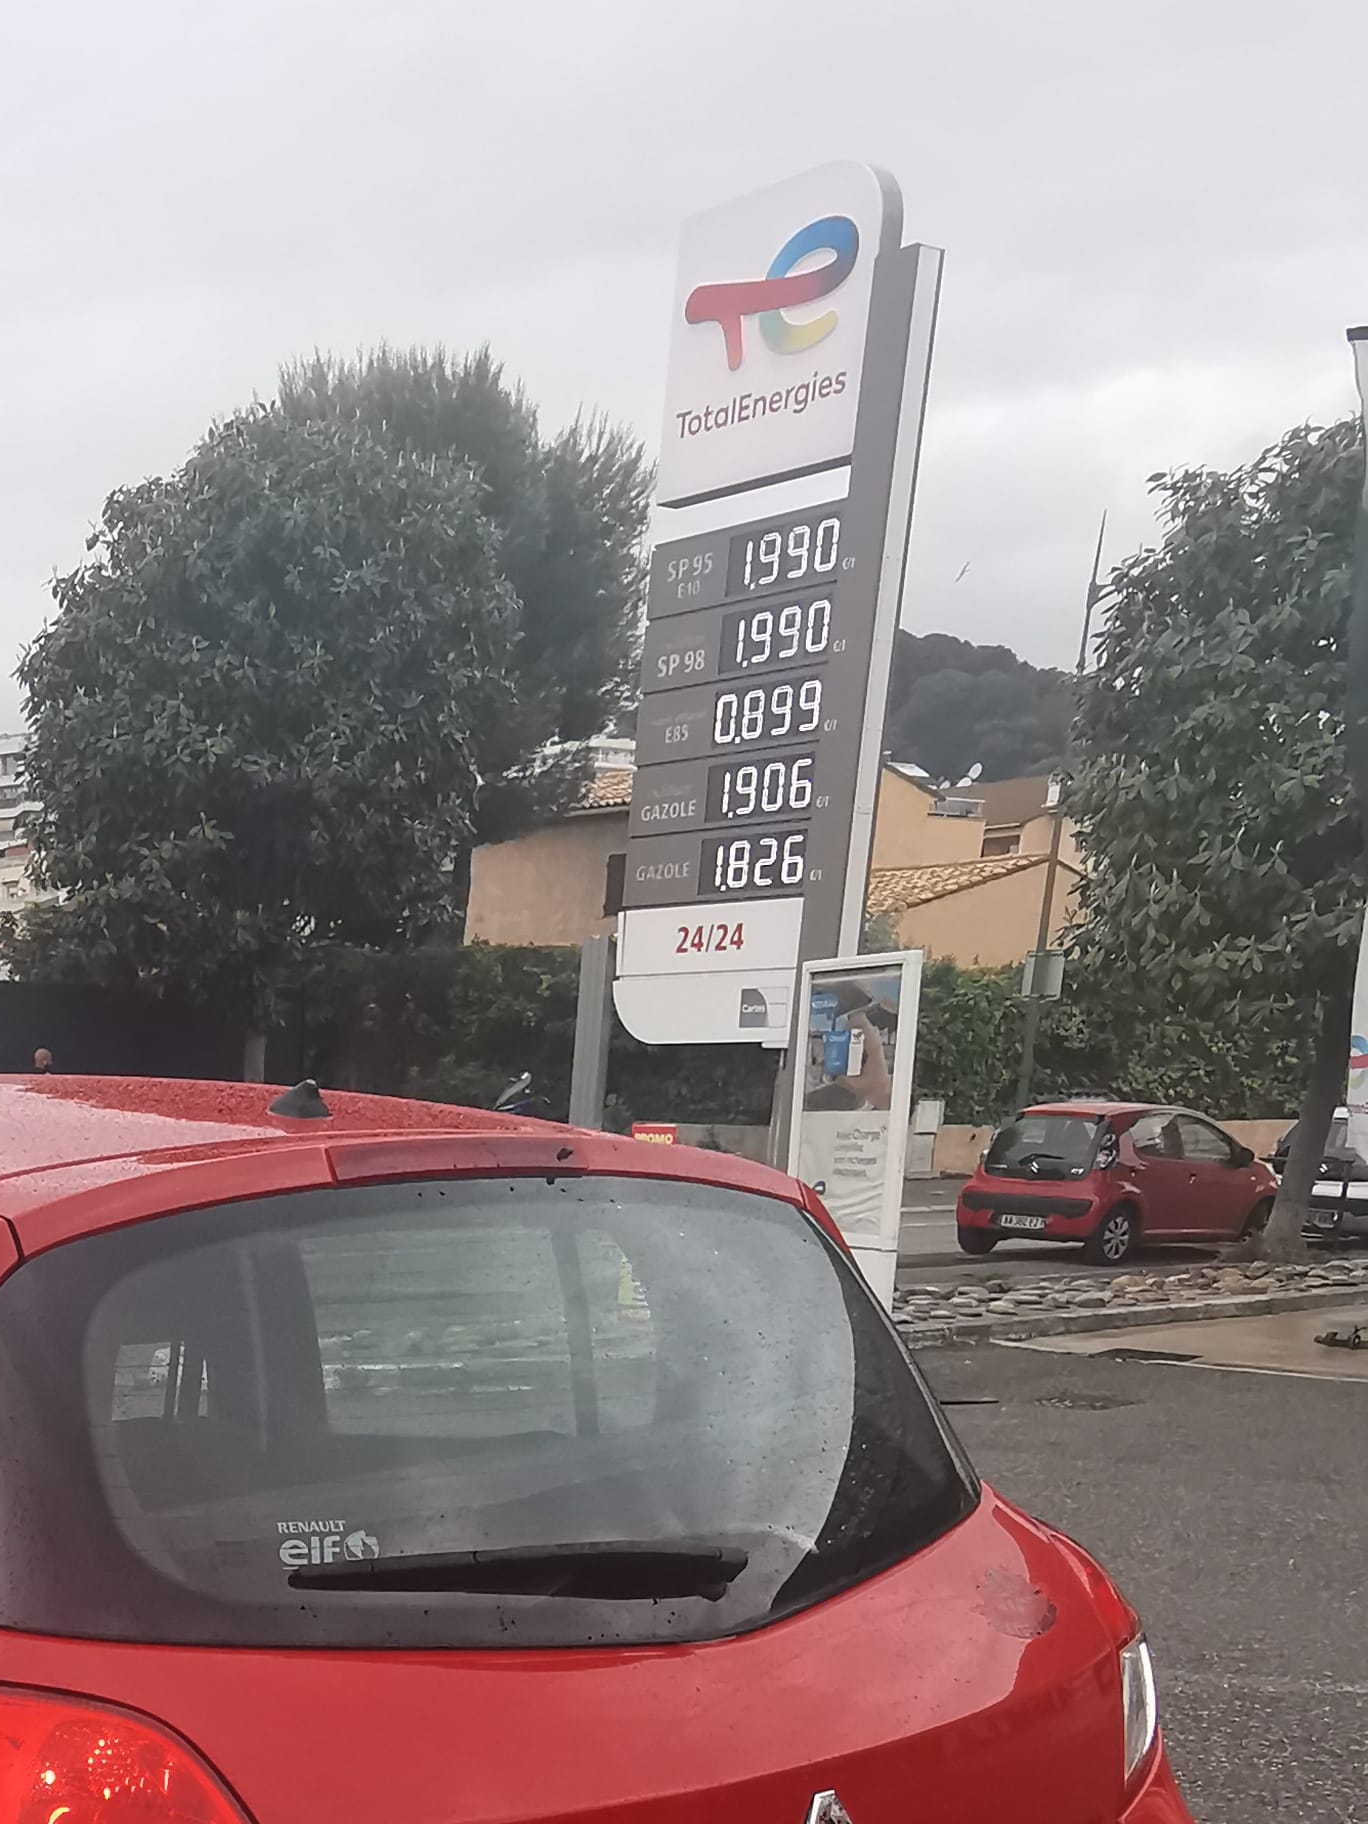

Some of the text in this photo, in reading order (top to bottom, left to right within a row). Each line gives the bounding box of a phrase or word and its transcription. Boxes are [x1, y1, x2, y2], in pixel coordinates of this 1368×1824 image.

[676, 368, 847, 439] TotalEnergies
[666, 553, 714, 583] SP 95
[743, 517, 841, 591] 1.990
[677, 581, 701, 599] E10
[735, 599, 832, 669] 1.990
[657, 649, 706, 678] SP 98
[713, 679, 823, 745] 0.899
[664, 724, 690, 744] E85
[721, 758, 813, 819] 1.906
[640, 799, 697, 822] GAZOLE
[635, 862, 691, 882] GAZOLE
[714, 834, 805, 892] 1.826
[675, 923, 745, 954] 24/24
[277, 1519, 346, 1534] RENAULT
[279, 1535, 341, 1566] elf
